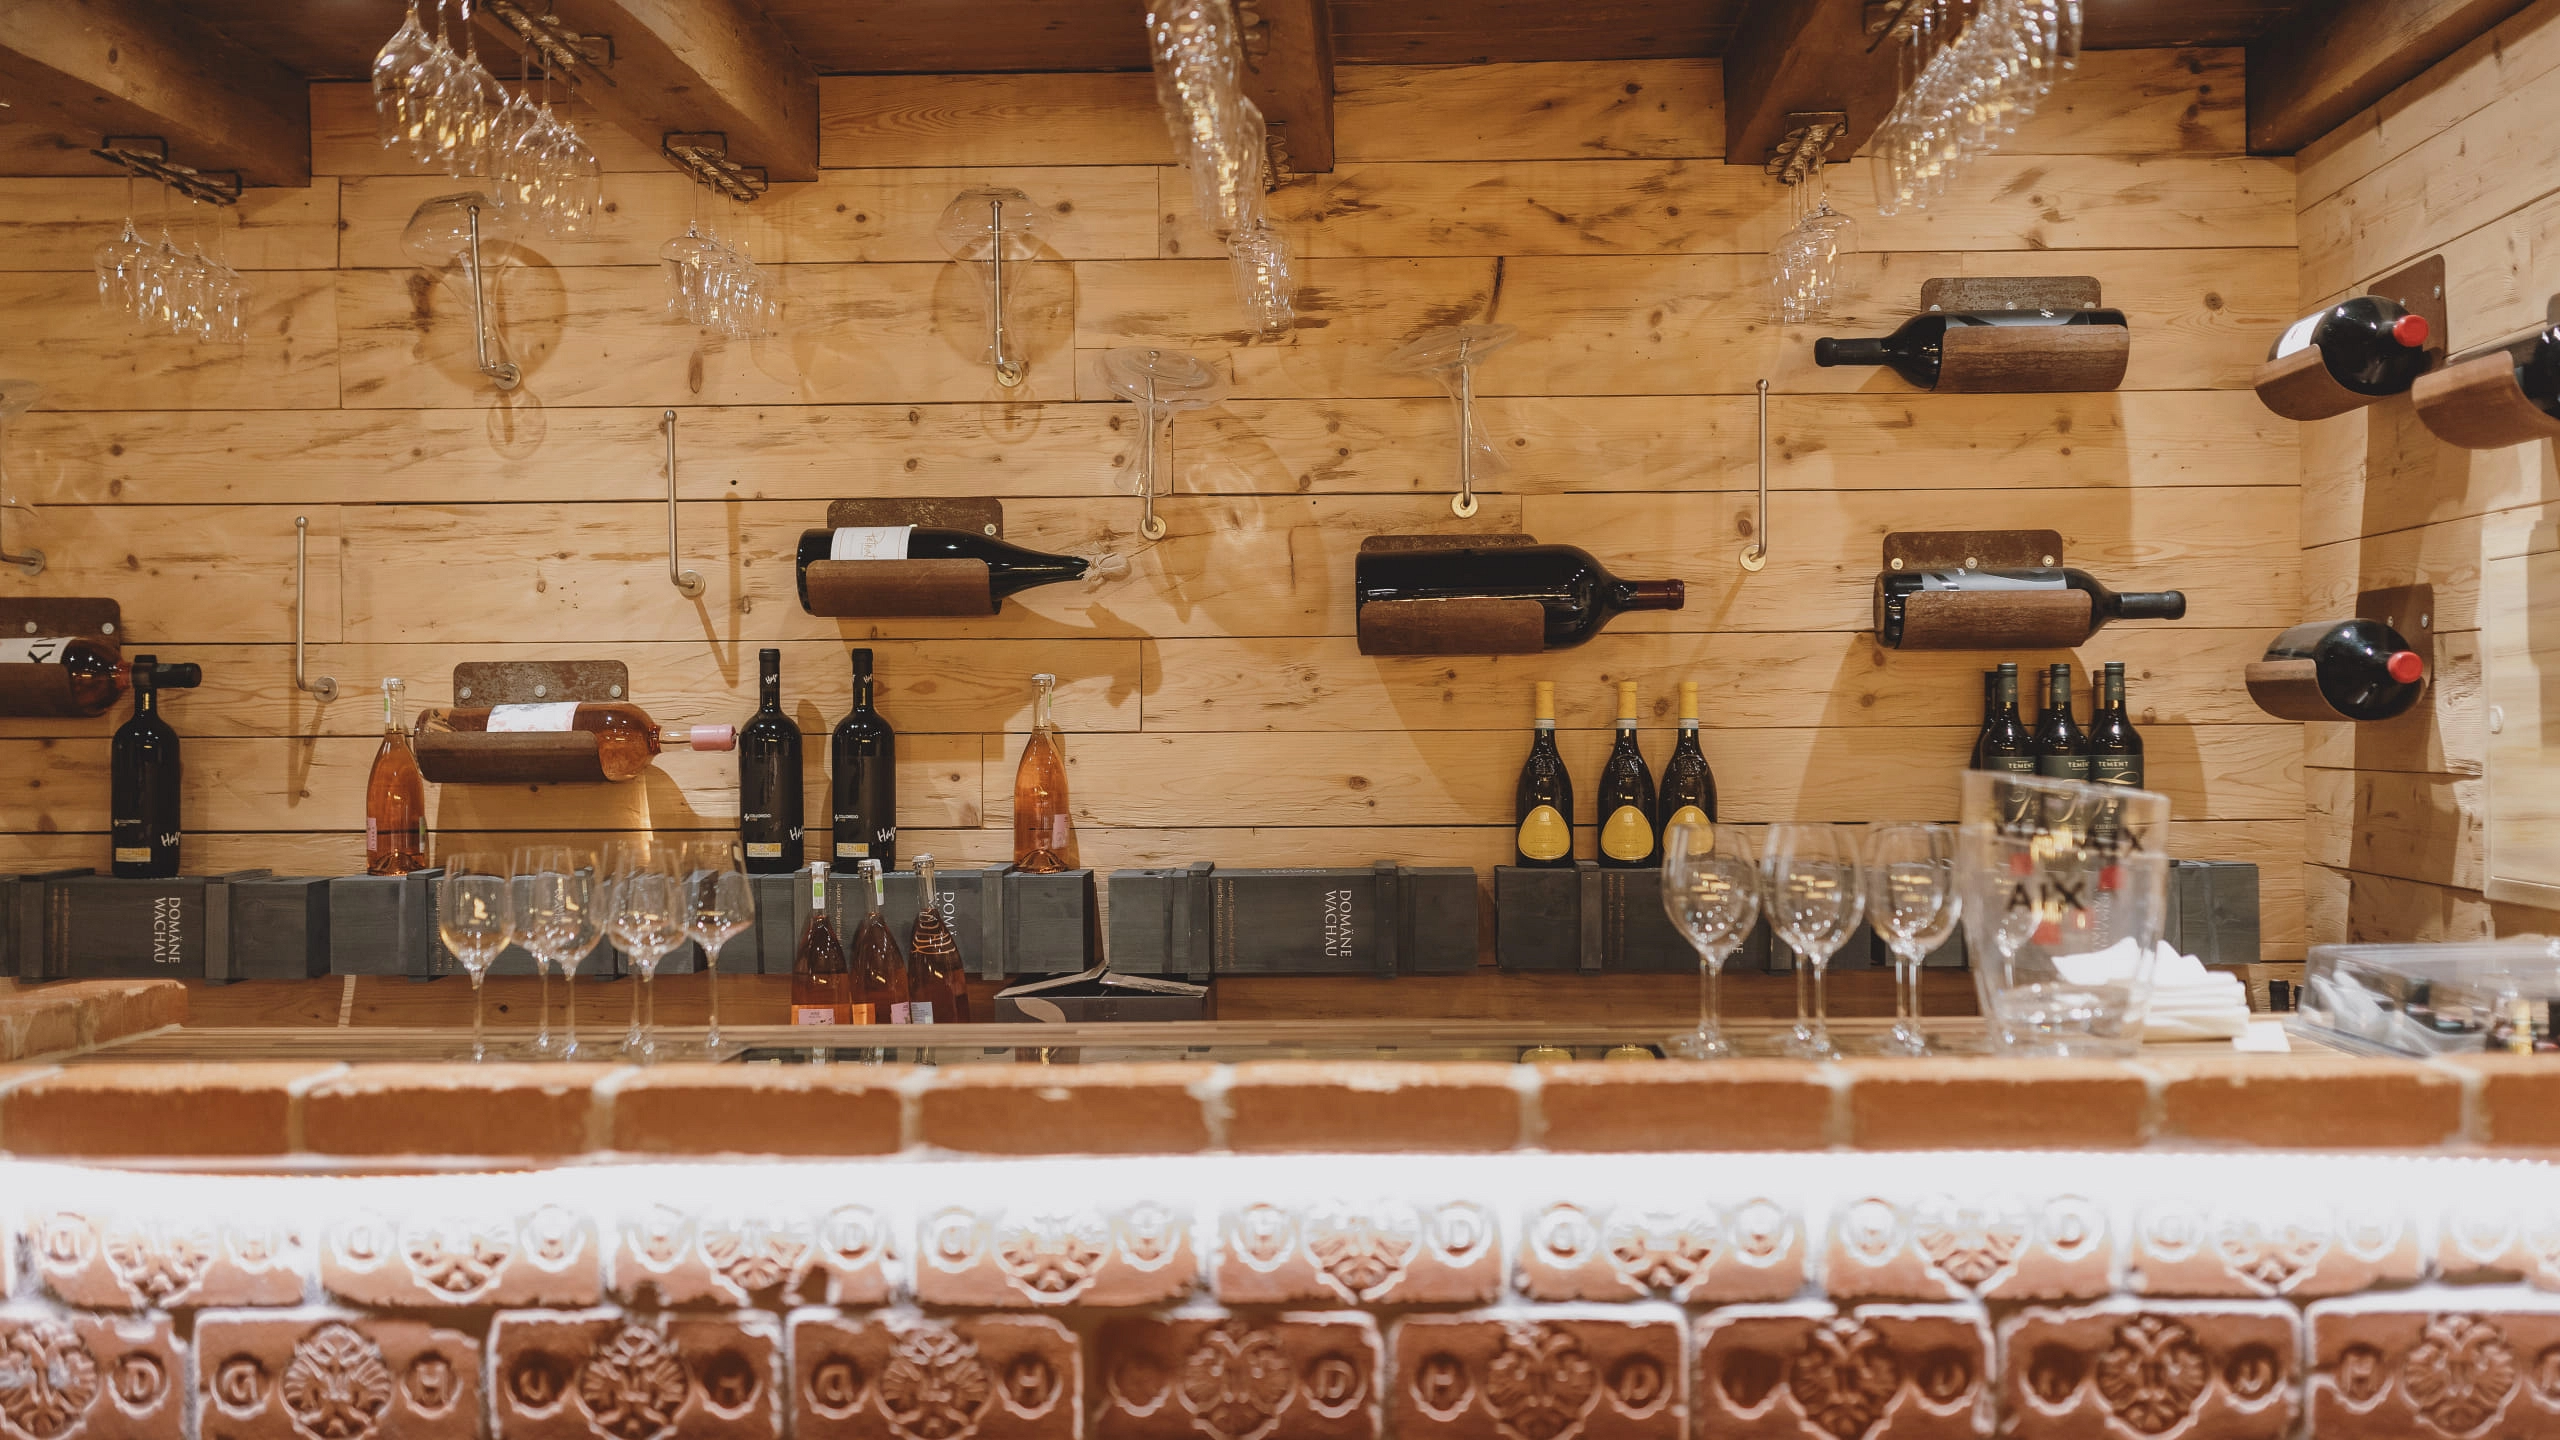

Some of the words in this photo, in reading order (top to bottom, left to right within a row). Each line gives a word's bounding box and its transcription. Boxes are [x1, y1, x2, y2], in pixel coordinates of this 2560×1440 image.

[1325, 890, 1337, 956] WACHAU
[1340, 890, 1354, 957] DOMÄNE
[2006, 881, 2087, 911] AIX
[153, 897, 166, 963] WACHAU
[168, 897, 184, 963] DOMÄNE
